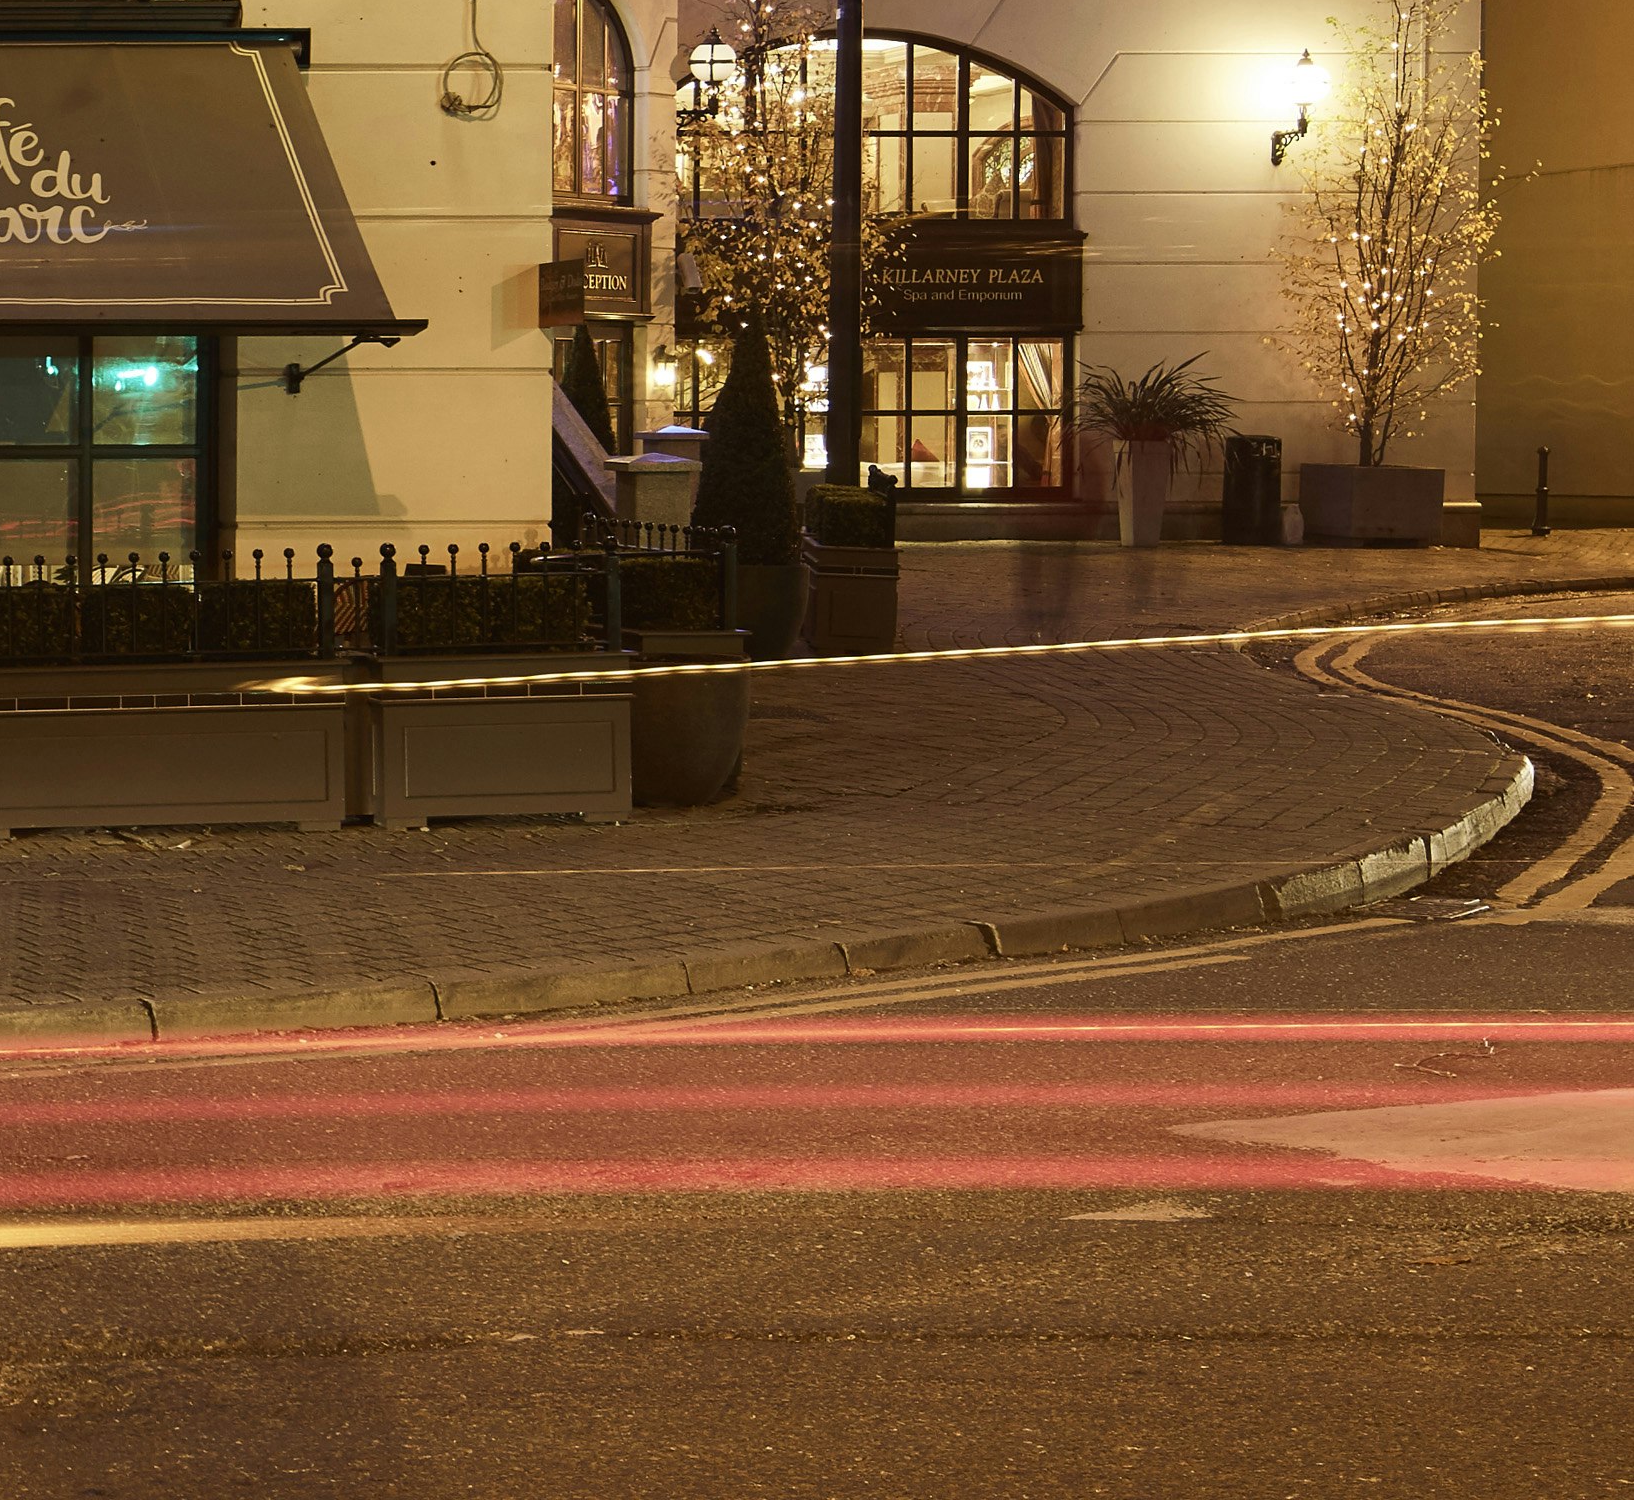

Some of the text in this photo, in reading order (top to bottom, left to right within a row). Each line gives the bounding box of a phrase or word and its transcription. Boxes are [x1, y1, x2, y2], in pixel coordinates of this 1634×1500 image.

[30, 150, 111, 205] du
[583, 273, 627, 291] CEPTION
[882, 268, 1044, 284] KILLARNEY PLAZA
[903, 288, 1023, 302] Spa and Emporium
